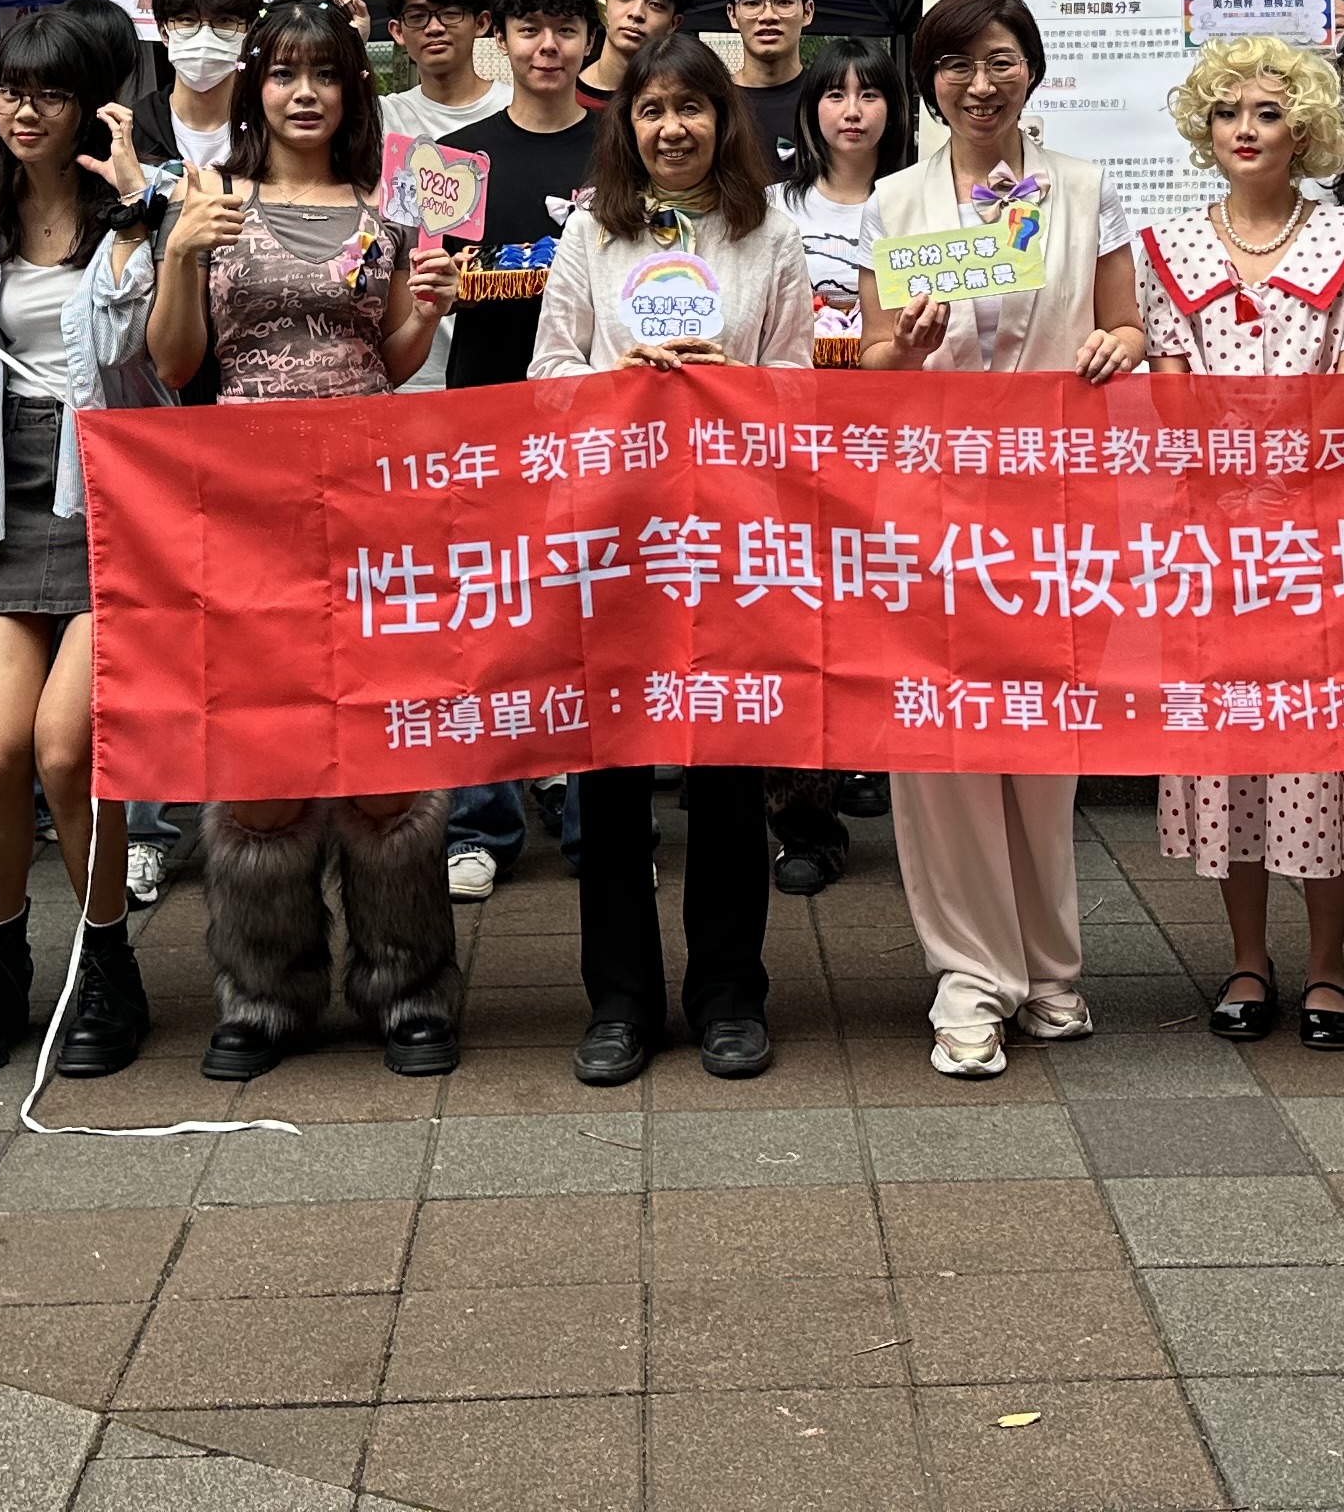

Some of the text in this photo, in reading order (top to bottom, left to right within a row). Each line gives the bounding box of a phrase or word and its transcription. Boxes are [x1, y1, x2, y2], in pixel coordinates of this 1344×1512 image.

[1060, 1, 1141, 15] 相關知識分享
[419, 167, 460, 201] Y2K
[422, 196, 455, 217] style
[889, 236, 999, 271] 妝扮平等
[632, 295, 715, 317] 性別平等
[641, 317, 702, 337] 教育日
[375, 443, 501, 491] 115年
[519, 419, 670, 484] 教育部
[383, 670, 785, 751] 指導單位：教育部
